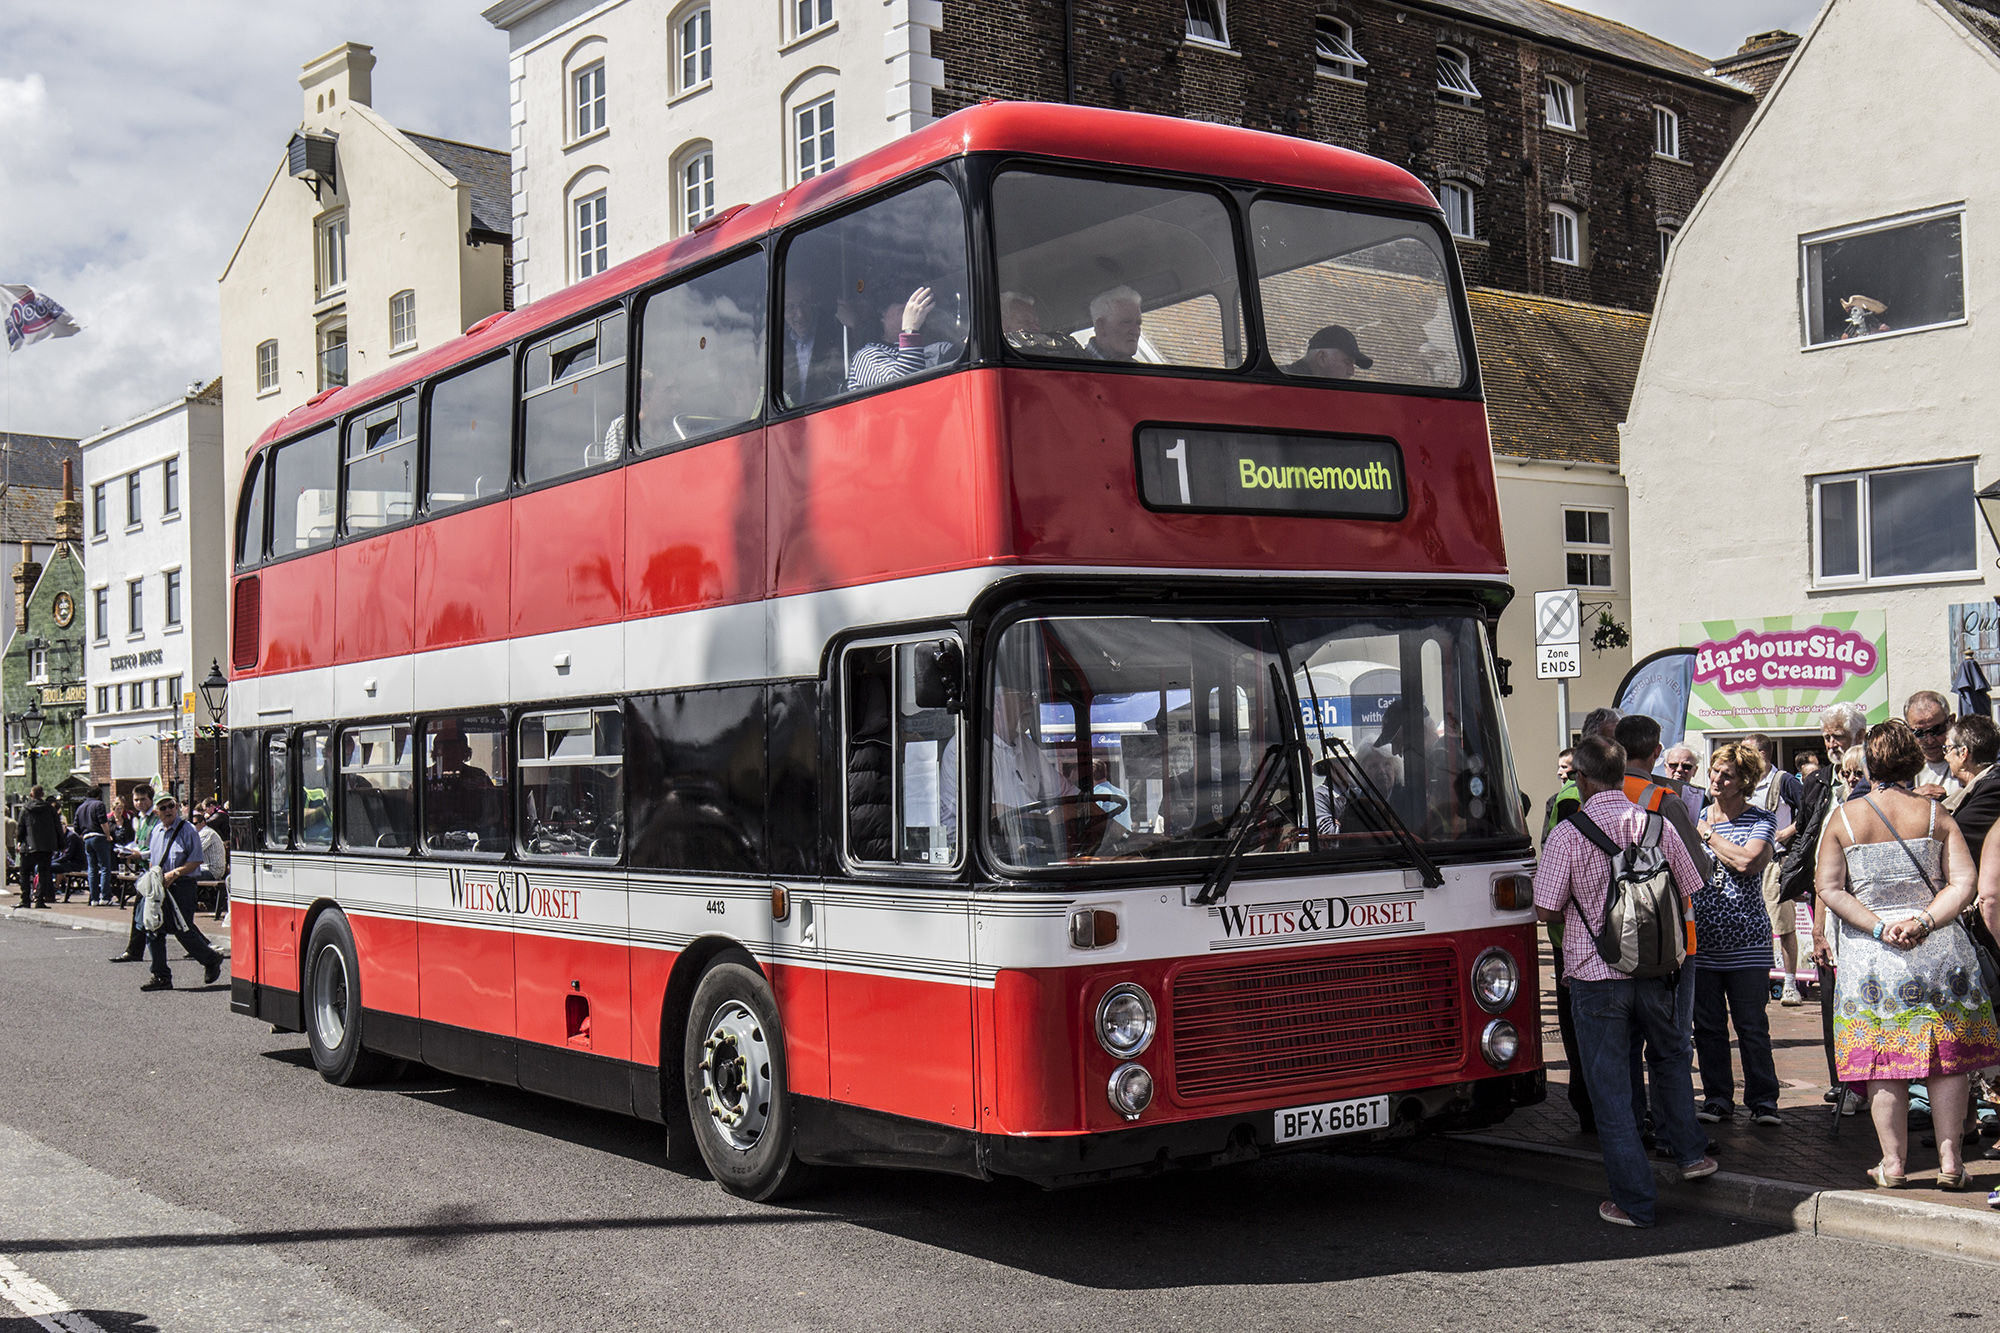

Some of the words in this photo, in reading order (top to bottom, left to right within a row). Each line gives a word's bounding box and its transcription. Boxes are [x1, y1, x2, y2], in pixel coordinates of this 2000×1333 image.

[1165, 438, 1191, 504] 1
[1239, 458, 1392, 490] Bournemouth
[138, 648, 163, 667] HOUSE
[1547, 649, 1569, 658] Zone
[1696, 635, 1870, 675] HarbourSide
[1541, 660, 1576, 673] ENDS
[1723, 666, 1757, 685] Ice
[1761, 660, 1837, 681] Cream
[65, 686, 86, 701] ARMS
[1627, 674, 1662, 705] HARBOUR
[1299, 700, 1337, 725] ash
[1710, 708, 1732, 716] Cream
[1736, 707, 1775, 715] Milkshakes
[706, 900, 726, 915] 4413
[1283, 1109, 1324, 1138] BFX
[1329, 1100, 1380, 1130] 666T
